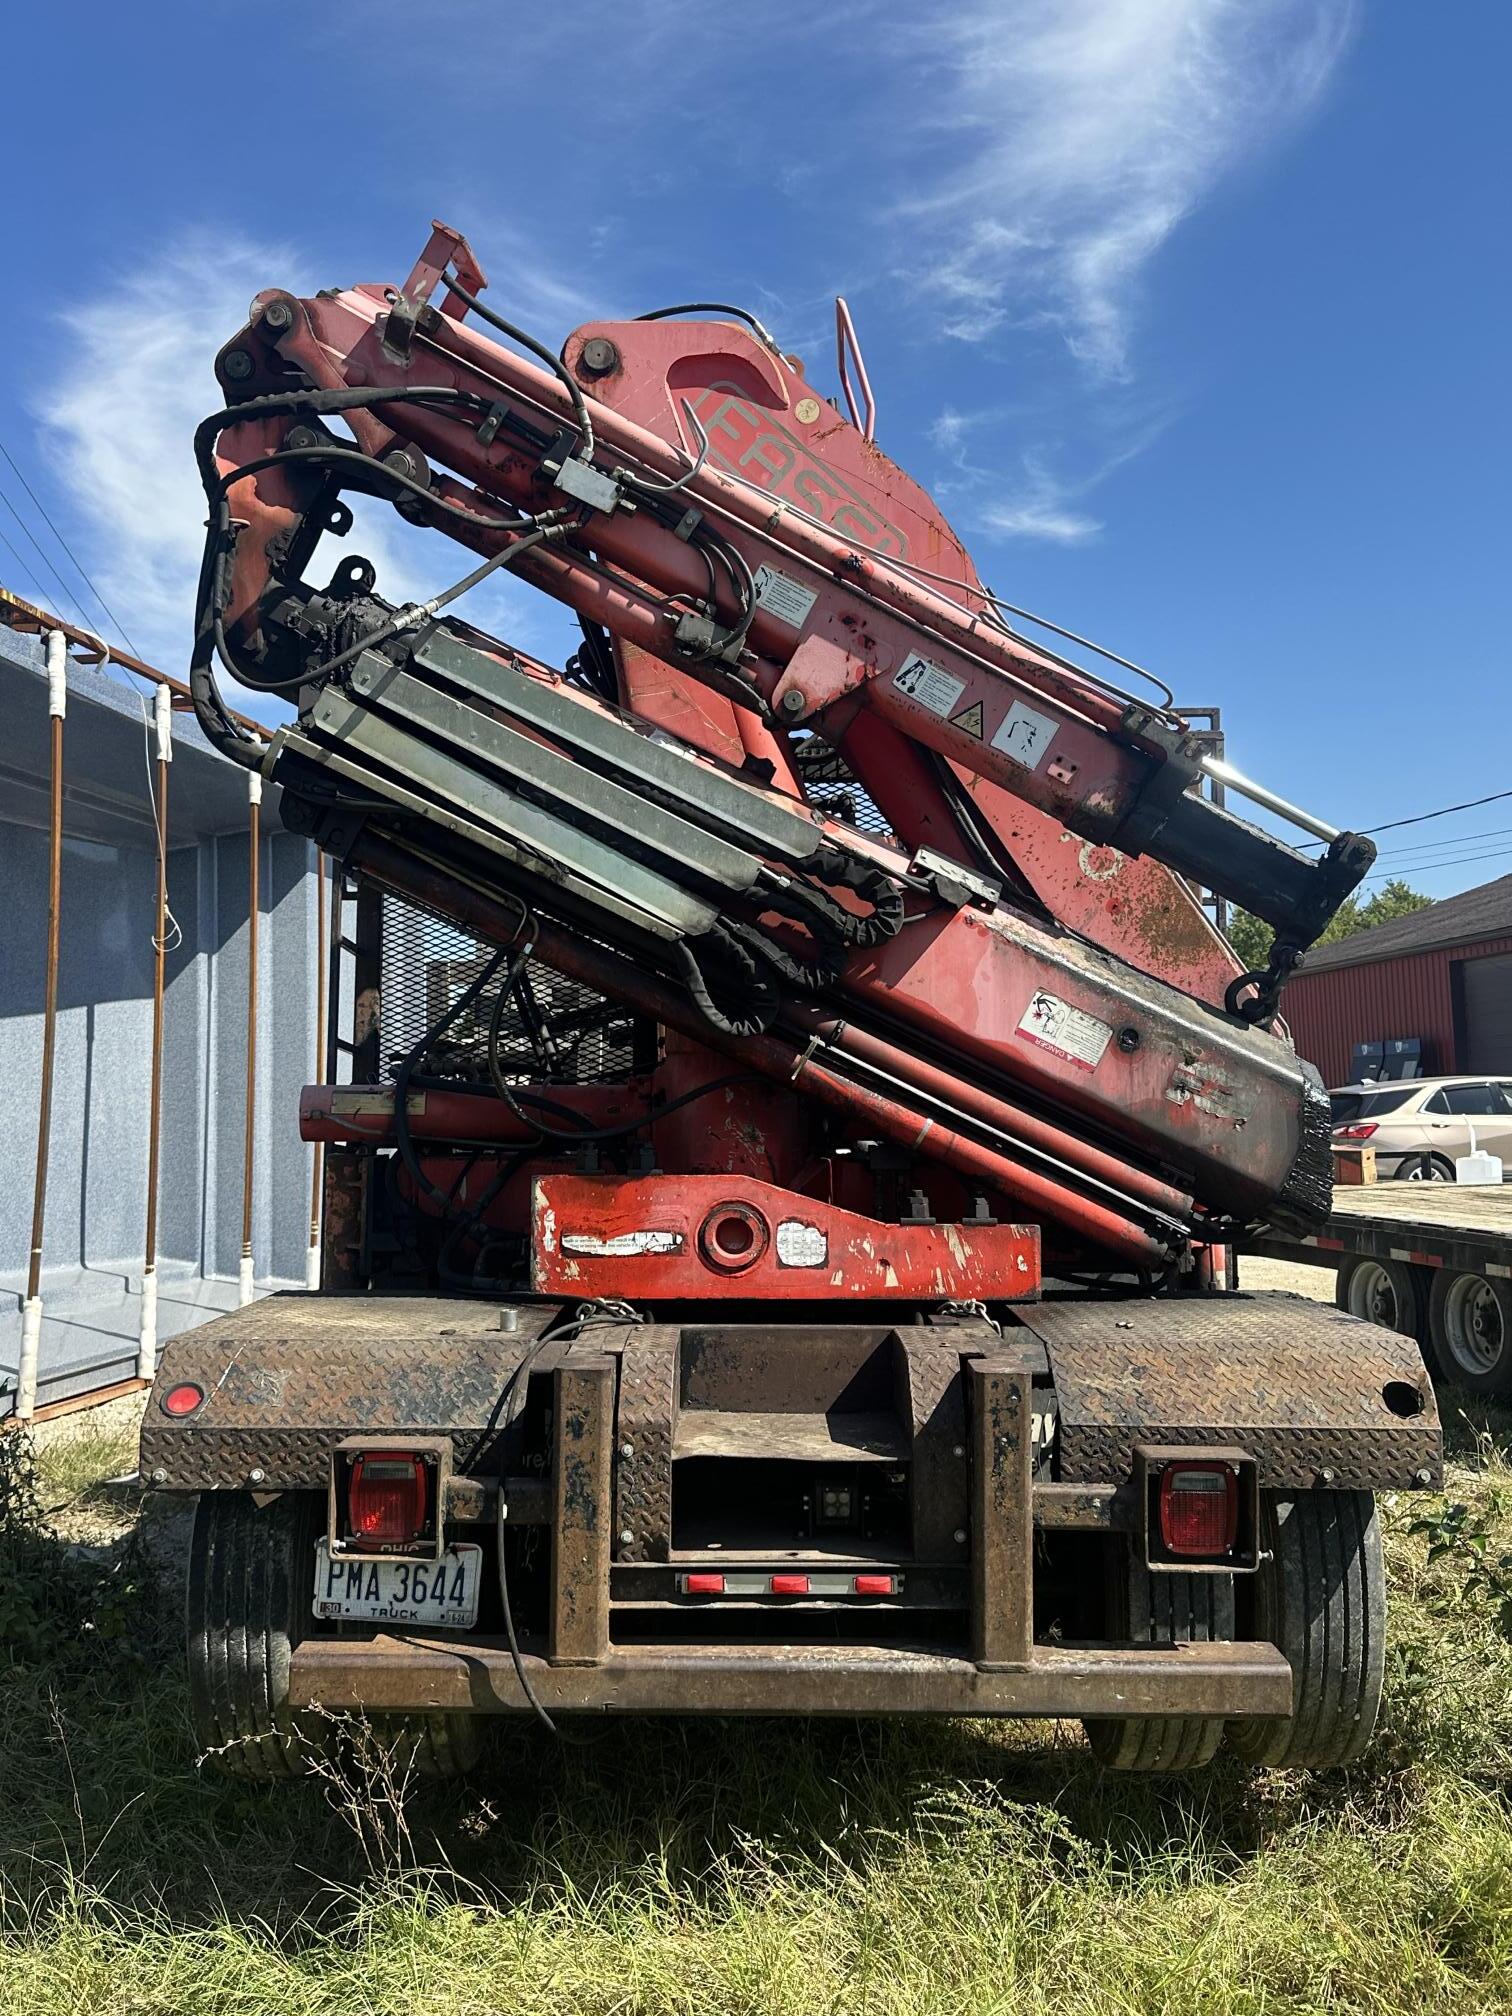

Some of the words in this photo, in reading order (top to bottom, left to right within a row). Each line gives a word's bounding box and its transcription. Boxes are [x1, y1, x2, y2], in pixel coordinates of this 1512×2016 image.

[1035, 1038, 1065, 1058] DANGER
[327, 1562, 380, 1601] PMA
[393, 1564, 465, 1607] 3644
[326, 1604, 339, 1613] 30
[371, 1608, 418, 1620] TRUCK
